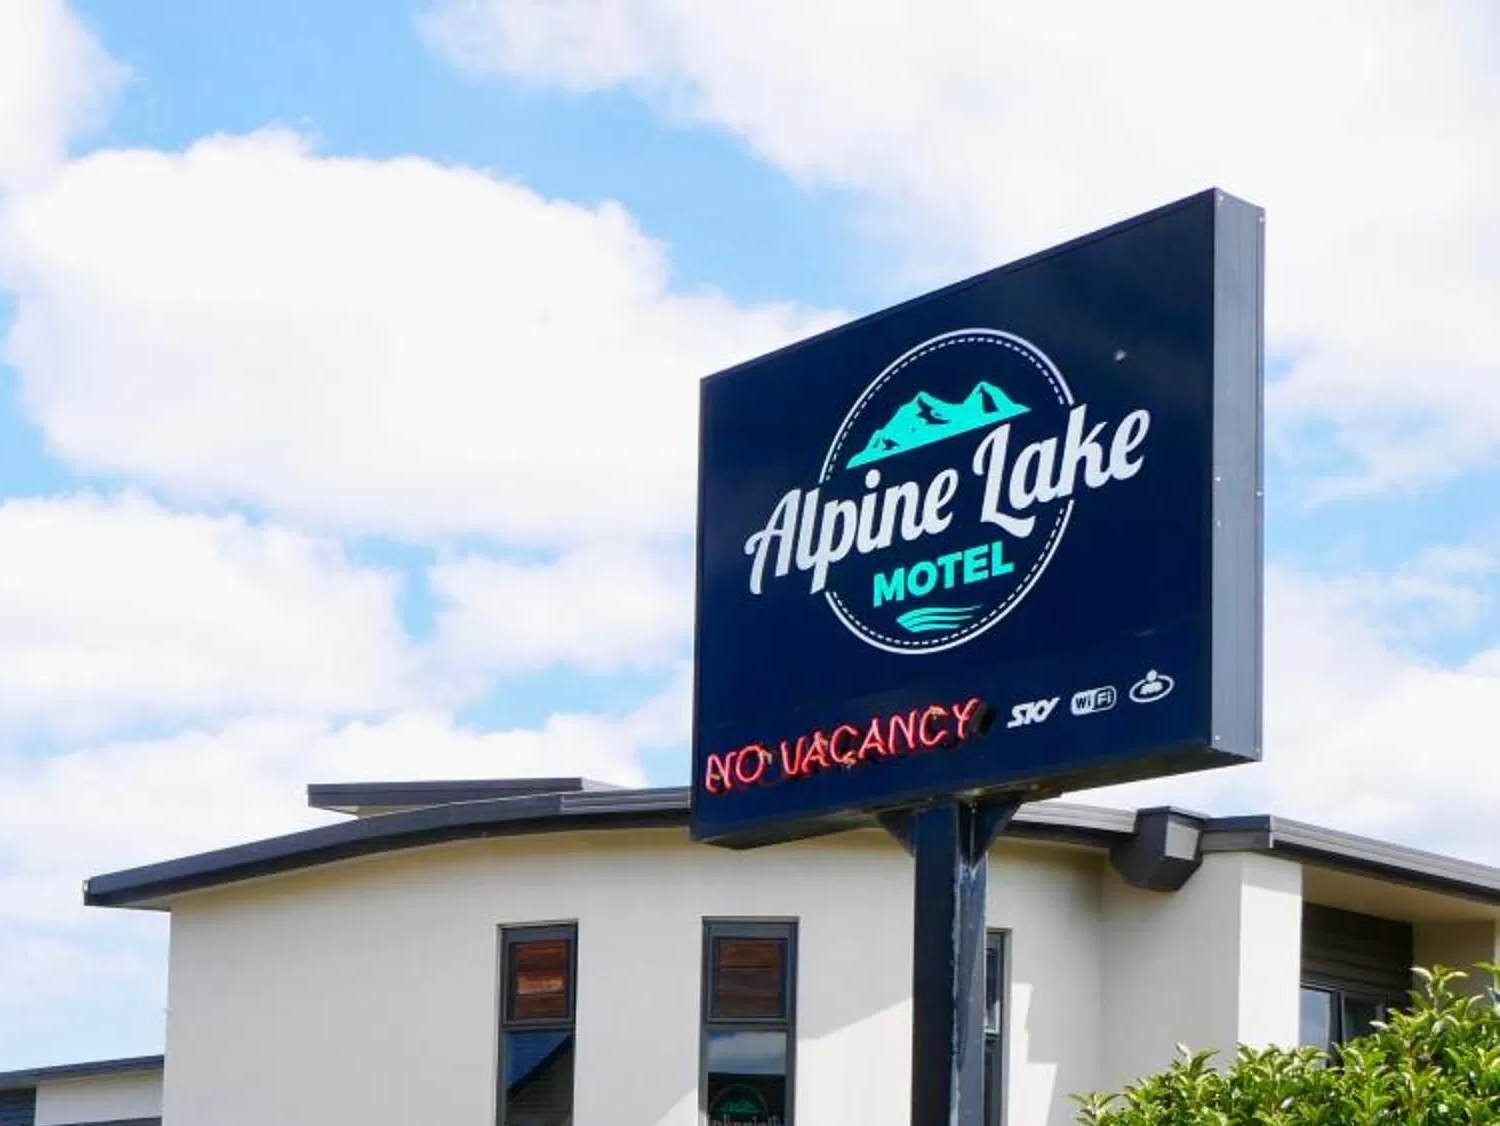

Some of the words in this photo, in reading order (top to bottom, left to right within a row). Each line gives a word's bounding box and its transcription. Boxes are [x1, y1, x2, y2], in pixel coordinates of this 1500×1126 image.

[743, 468, 959, 595] Alpine
[971, 403, 1151, 539] Lake
[873, 540, 1015, 609] MOTEL
[704, 744, 766, 793] NO
[780, 697, 981, 777] VACANCY
